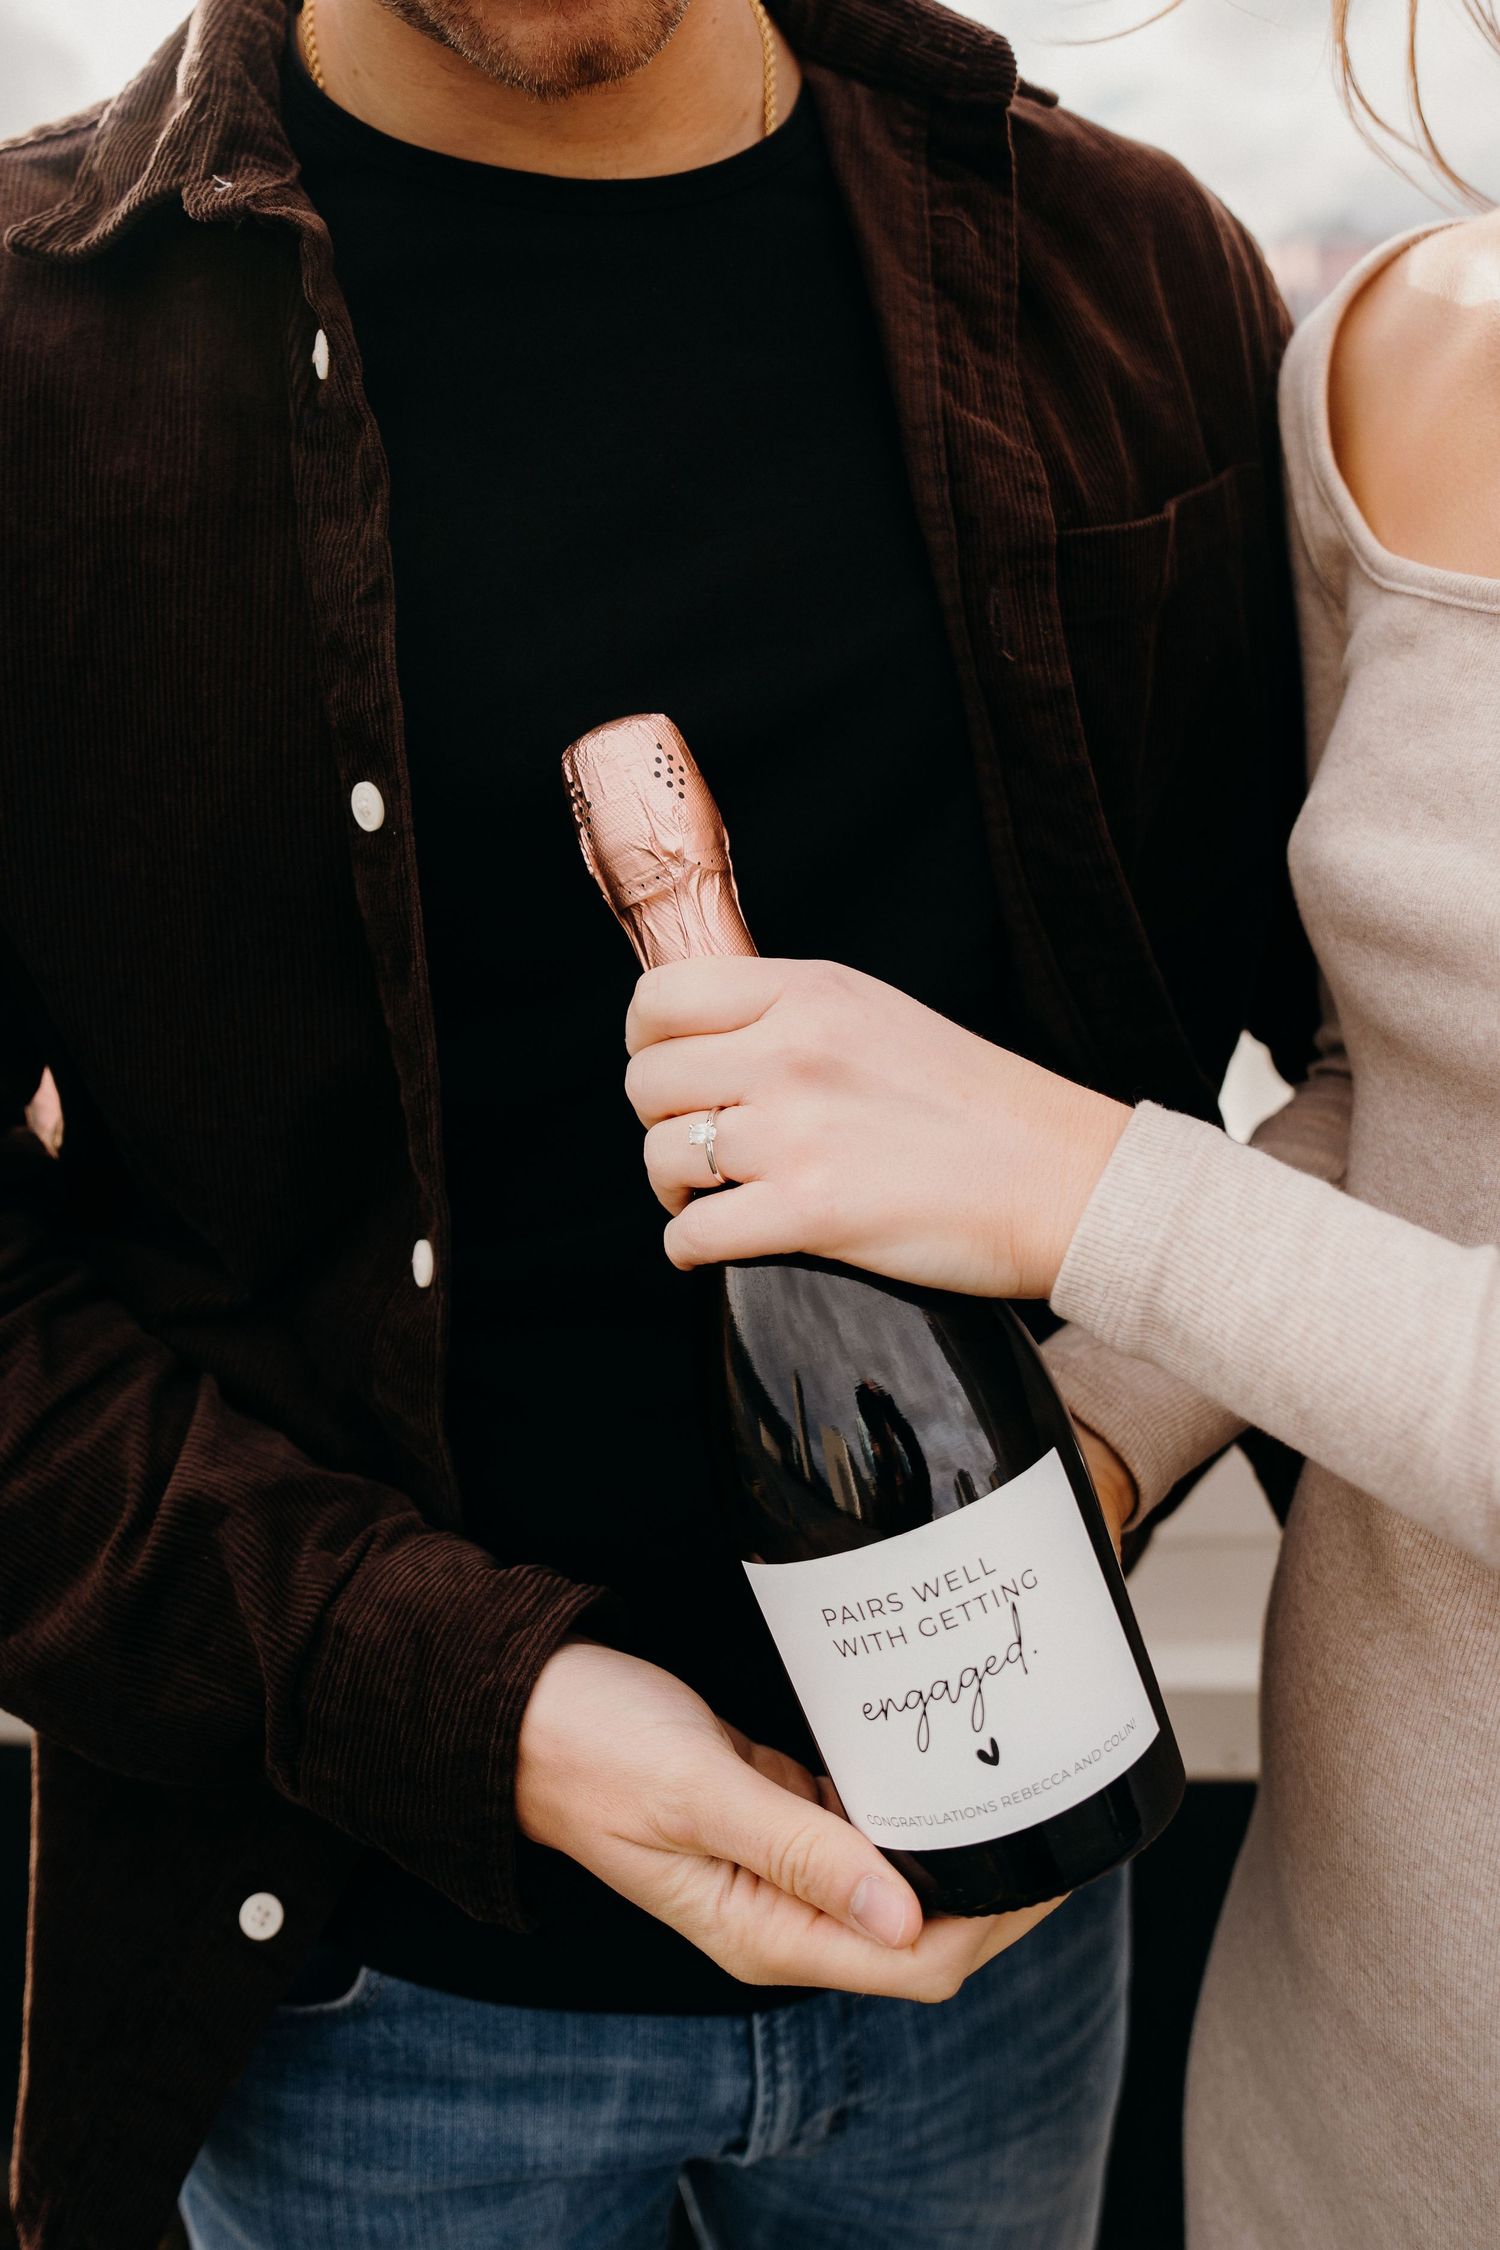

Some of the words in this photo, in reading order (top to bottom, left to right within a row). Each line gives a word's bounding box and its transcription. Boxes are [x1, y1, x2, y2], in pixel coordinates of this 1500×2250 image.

[822, 1592, 904, 1627] PAIRS
[911, 1558, 997, 1602] WELL
[833, 1626, 908, 1658] WITH
[918, 1568, 1039, 1637] GETTING
[862, 1602, 1038, 1753] engaged.
[866, 1800, 999, 1828] CONGRATULATIONS
[1001, 1769, 1072, 1808] REBECCA
[1074, 1748, 1102, 1774] AND
[1103, 1716, 1137, 1753] COLIN!
